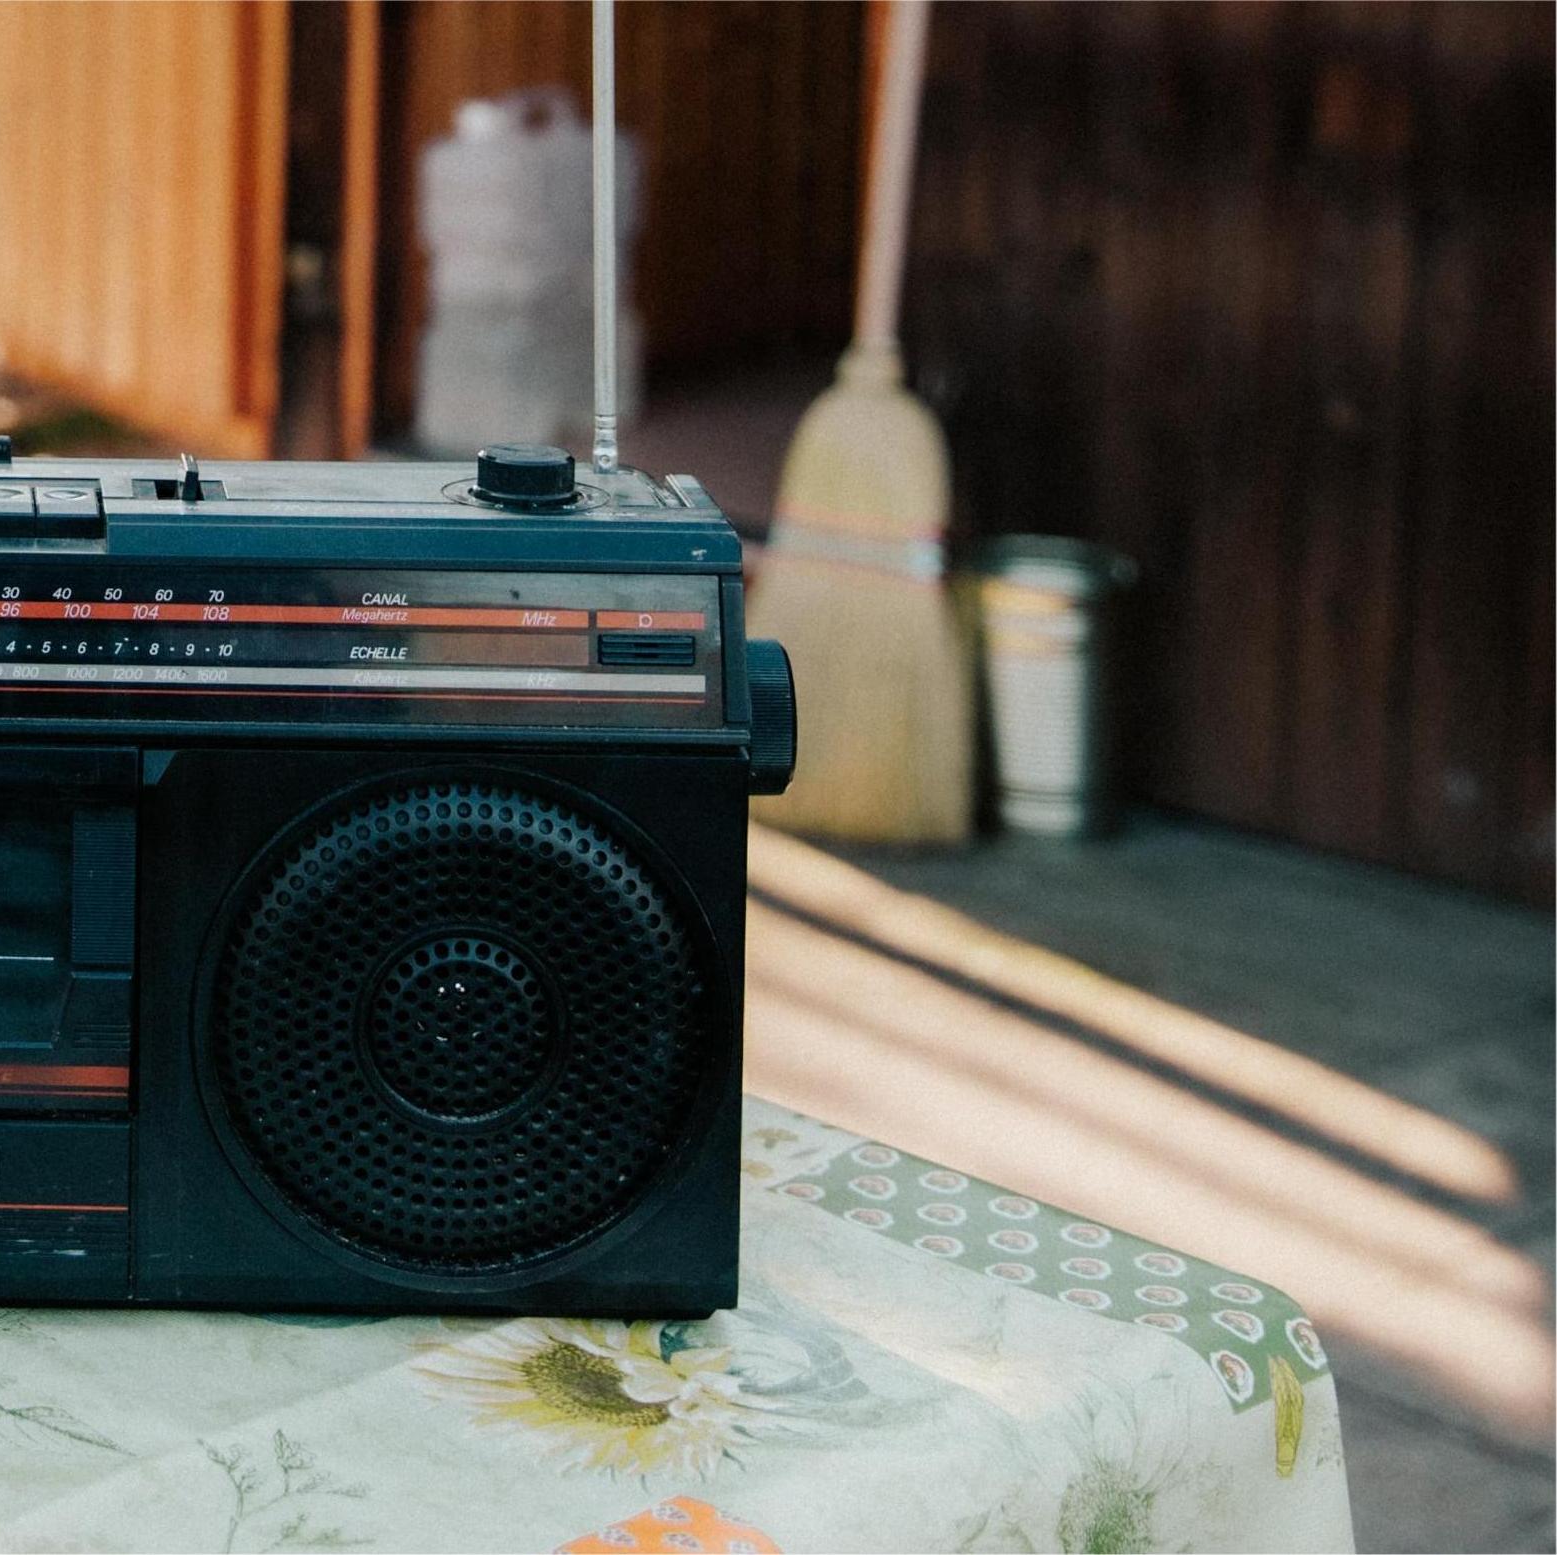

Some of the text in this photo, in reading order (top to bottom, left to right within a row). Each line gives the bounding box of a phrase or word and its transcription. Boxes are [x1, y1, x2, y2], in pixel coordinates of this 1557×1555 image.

[1, 586, 20, 599] 30
[52, 587, 72, 600] 40
[104, 588, 123, 601] 50
[155, 588, 173, 602] 60
[208, 589, 225, 602] 70
[362, 592, 409, 606] CANAL
[0, 602, 21, 617] 96
[63, 603, 92, 619] 100
[132, 604, 160, 620] 104
[202, 605, 230, 621] 108
[342, 608, 409, 623] Megahertz
[522, 612, 557, 627] MHz
[5, 640, 16, 653] 4
[41, 640, 52, 654] 5
[77, 641, 88, 655] 6
[114, 642, 123, 655] 7
[149, 642, 160, 656] 8
[185, 643, 195, 656] 9
[218, 643, 233, 657] 10
[349, 646, 409, 660] ECHELLE
[12, 665, 39, 679] 800
[66, 667, 98, 681] 1000
[112, 668, 144, 681] 1200
[154, 668, 187, 682] 1400
[197, 668, 227, 683] 1600
